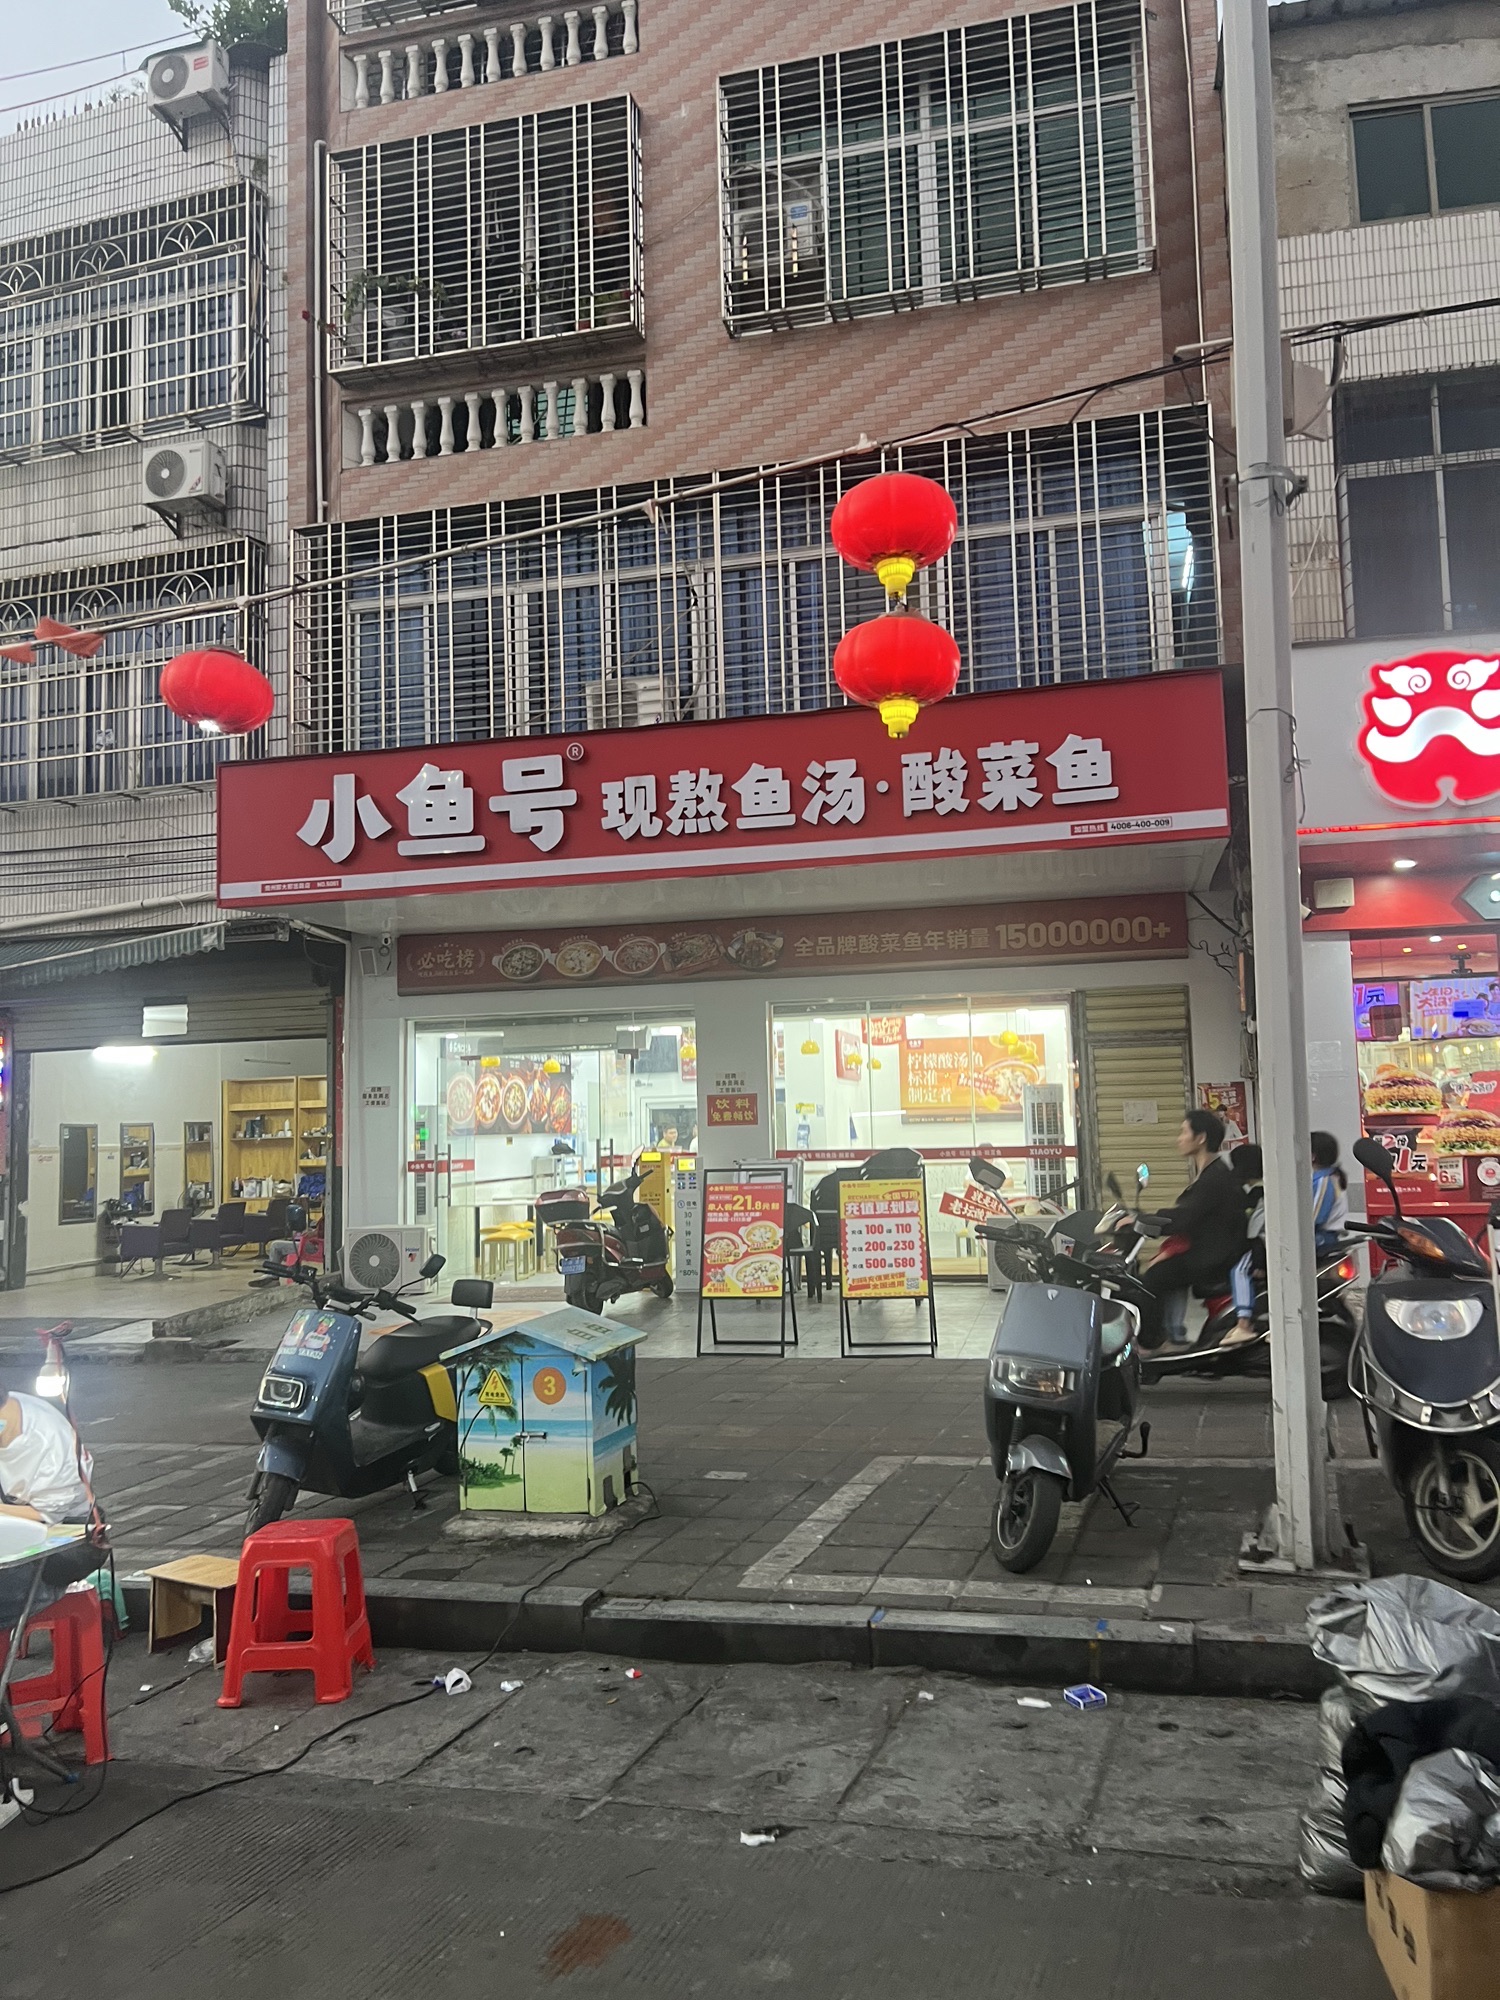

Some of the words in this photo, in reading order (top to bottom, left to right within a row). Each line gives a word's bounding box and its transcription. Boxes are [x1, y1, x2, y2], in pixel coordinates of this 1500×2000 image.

[296, 754, 577, 864] 小鱼号
[1110, 819, 1170, 830] 4006-400-009
[793, 927, 991, 958] 全品牌酸菜鱼年销量
[995, 916, 1171, 950] 15000000+
[417, 948, 476, 971] 必吃榜
[907, 1051, 984, 1070] 柠檬酸汤鱼
[907, 1069, 938, 1087] 标准
[908, 1086, 953, 1104] 制定者
[845, 1200, 919, 1215] 充值更划算
[865, 1224, 884, 1234] 100
[895, 1223, 912, 1234] 110
[865, 1241, 886, 1252] 200
[894, 1240, 915, 1251] 230
[865, 1258, 887, 1269] 500
[894, 1257, 916, 1268] 580
[543, 1375, 556, 1396] 3
